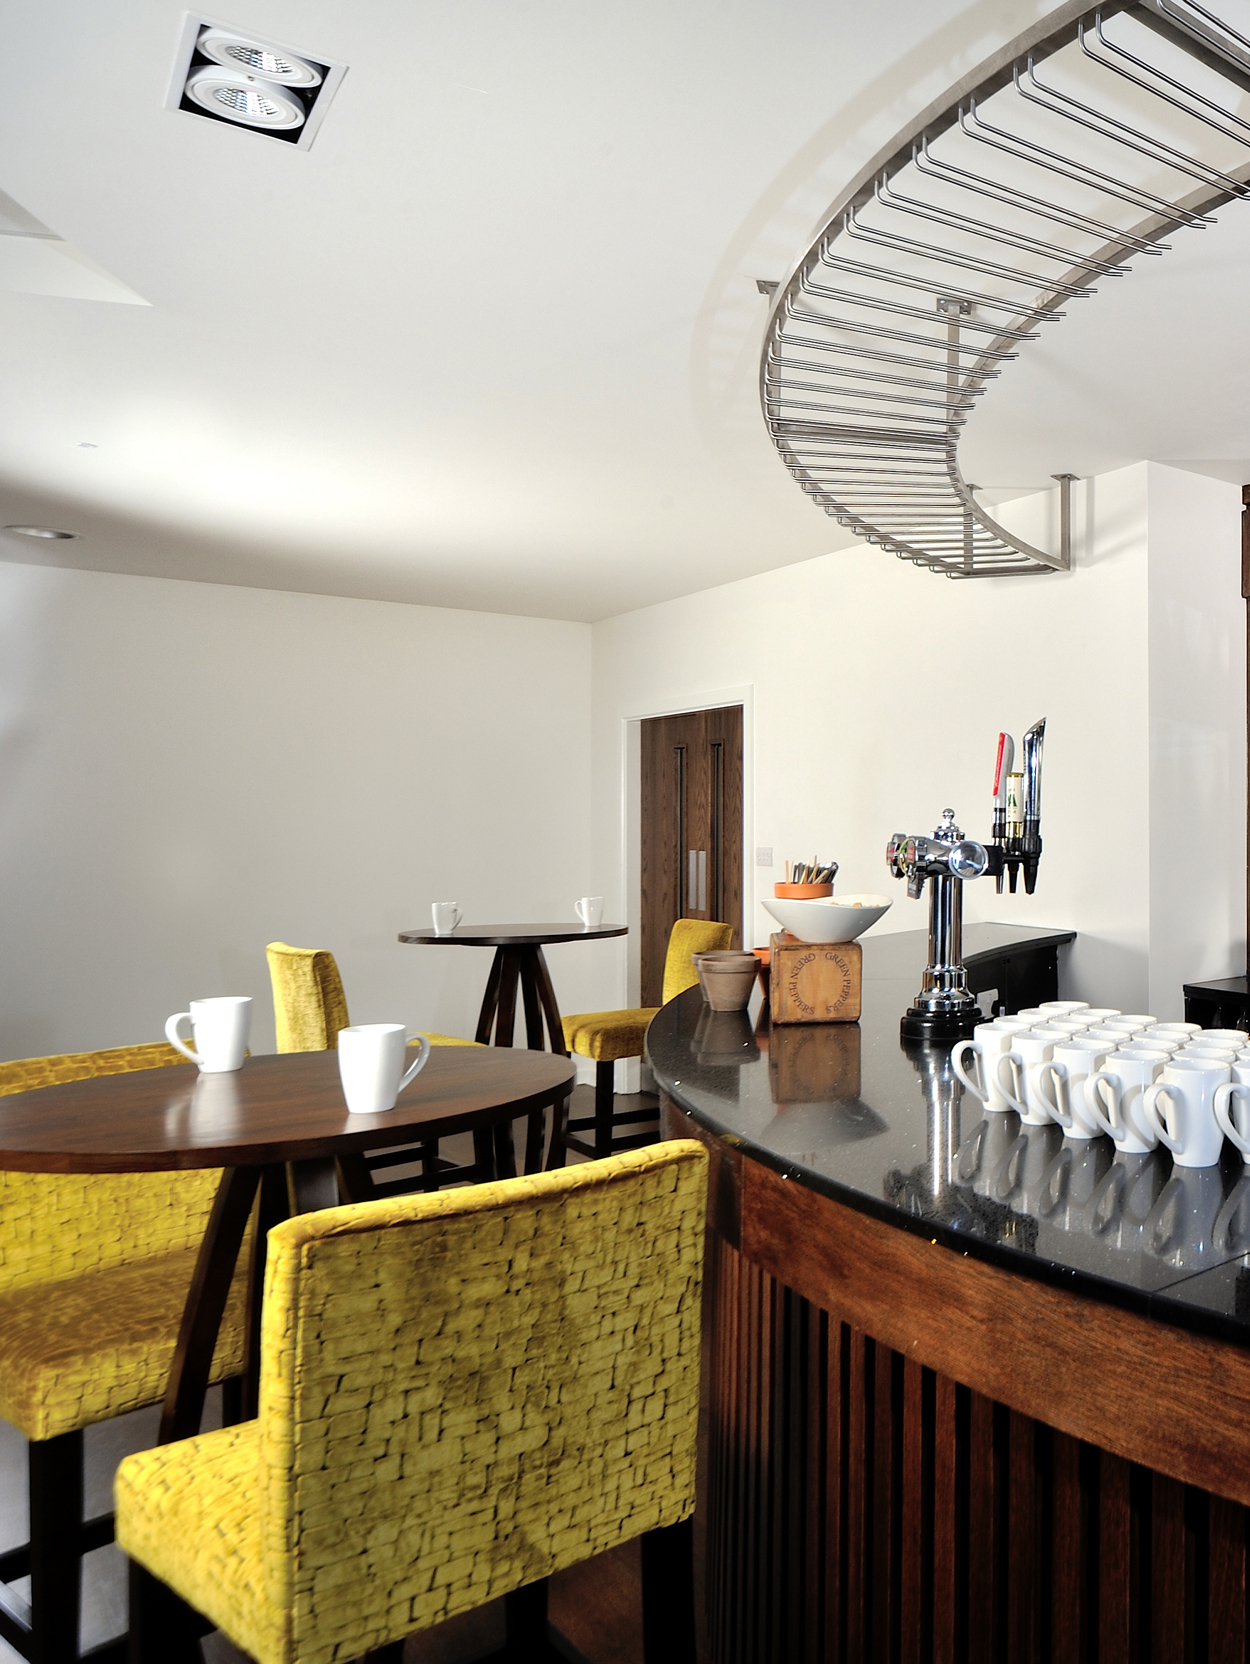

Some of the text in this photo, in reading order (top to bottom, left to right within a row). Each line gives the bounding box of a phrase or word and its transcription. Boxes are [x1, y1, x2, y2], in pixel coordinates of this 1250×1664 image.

[789, 952, 816, 1015] GREEN PEPPERS
[825, 951, 852, 1014] GREEN PEPPERS
